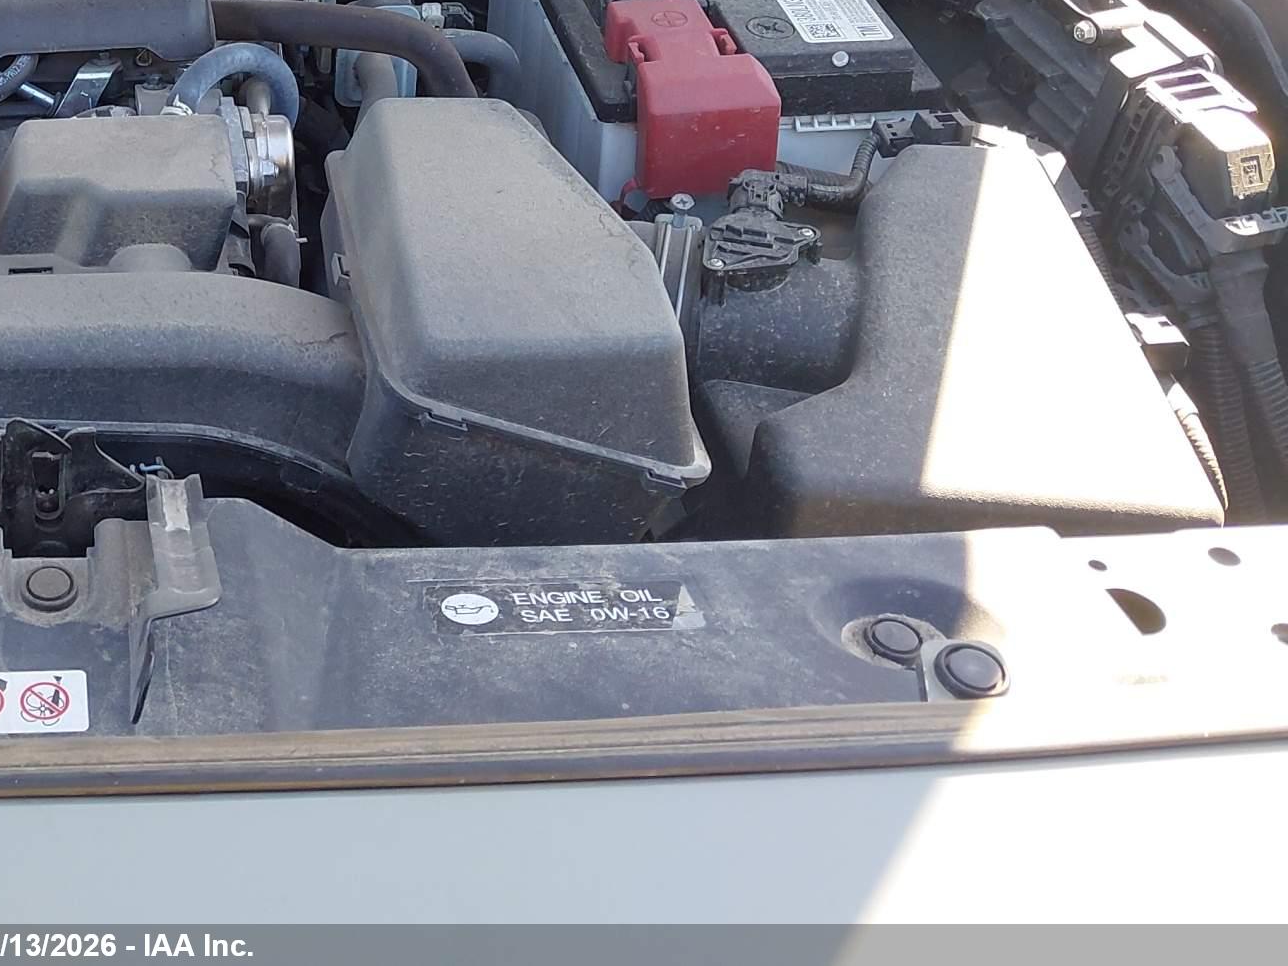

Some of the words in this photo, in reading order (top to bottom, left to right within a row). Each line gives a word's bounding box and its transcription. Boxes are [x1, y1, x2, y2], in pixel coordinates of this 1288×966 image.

[511, 590, 606, 605] ENGINE
[620, 589, 663, 602] OIL
[520, 608, 573, 623] SAE
[590, 606, 670, 621] 0W-16
